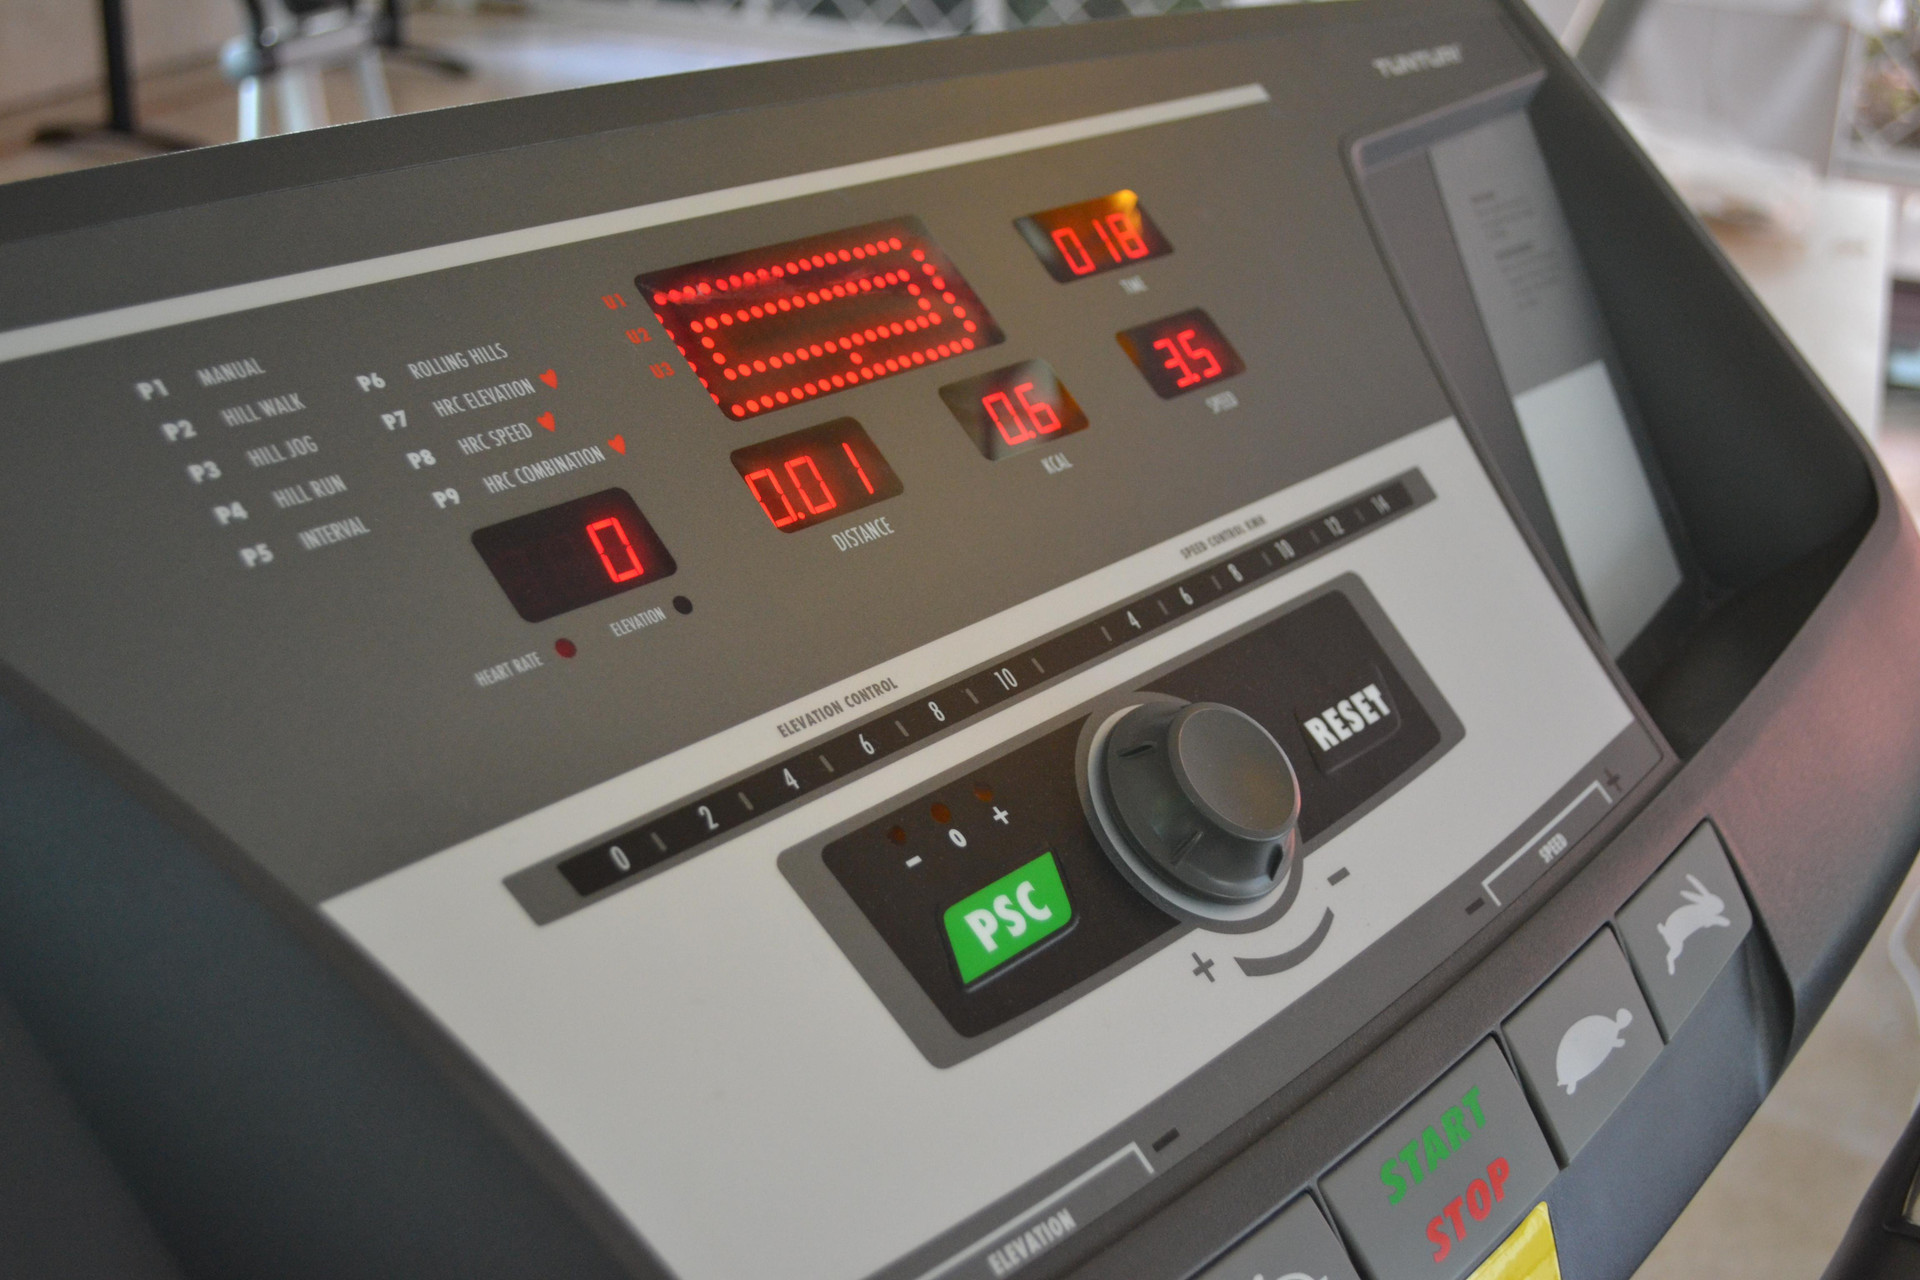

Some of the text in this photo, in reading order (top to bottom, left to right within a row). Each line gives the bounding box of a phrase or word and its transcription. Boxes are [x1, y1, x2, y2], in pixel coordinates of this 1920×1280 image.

[601, 293, 627, 311] U1
[626, 327, 652, 344] U2
[197, 357, 266, 387] MANUAL
[407, 342, 509, 379] ROLLING HILLS
[650, 362, 675, 379] U3
[135, 378, 169, 400] P1
[356, 372, 386, 392] P6
[432, 378, 536, 417] HRC ELEVATION
[221, 393, 307, 426] HILL WALK
[380, 410, 408, 430] P7
[982, 382, 1062, 446] 0.6
[161, 420, 197, 441] P2
[457, 422, 533, 455] HRC SPEED
[247, 435, 319, 467] HILL JOG
[406, 449, 437, 470] P8
[1040, 453, 1074, 475] KCAL
[187, 460, 223, 483] P3
[482, 445, 606, 494] HRC COMBINATION
[272, 474, 348, 508] HILL RUN
[431, 488, 461, 509] P9
[214, 502, 249, 525] P4
[298, 516, 371, 550] INTERVAL
[831, 516, 895, 552] DISTANCE
[1180, 541, 1209, 559] SPEED
[1207, 524, 1245, 546] CONTROL
[239, 544, 275, 567] P5
[585, 516, 645, 584] 0
[1126, 610, 1142, 629] 4
[1178, 586, 1194, 605] 6
[1226, 563, 1244, 582] 8
[1274, 539, 1296, 560] 10
[1323, 515, 1345, 537] 12
[609, 606, 668, 637] ELEVATION
[474, 651, 544, 687] HEART RATE
[776, 676, 899, 738] ELEVATION CONTROL
[1303, 683, 1391, 752] RESET
[609, 667, 1018, 871] 0 2 4 6 8 10
[1537, 832, 1568, 864] SPEED
[963, 880, 1053, 953] PSC
[1379, 1086, 1488, 1205] START
[1425, 1156, 1511, 1263] STOP
[987, 1208, 1077, 1278] ELEVATION
